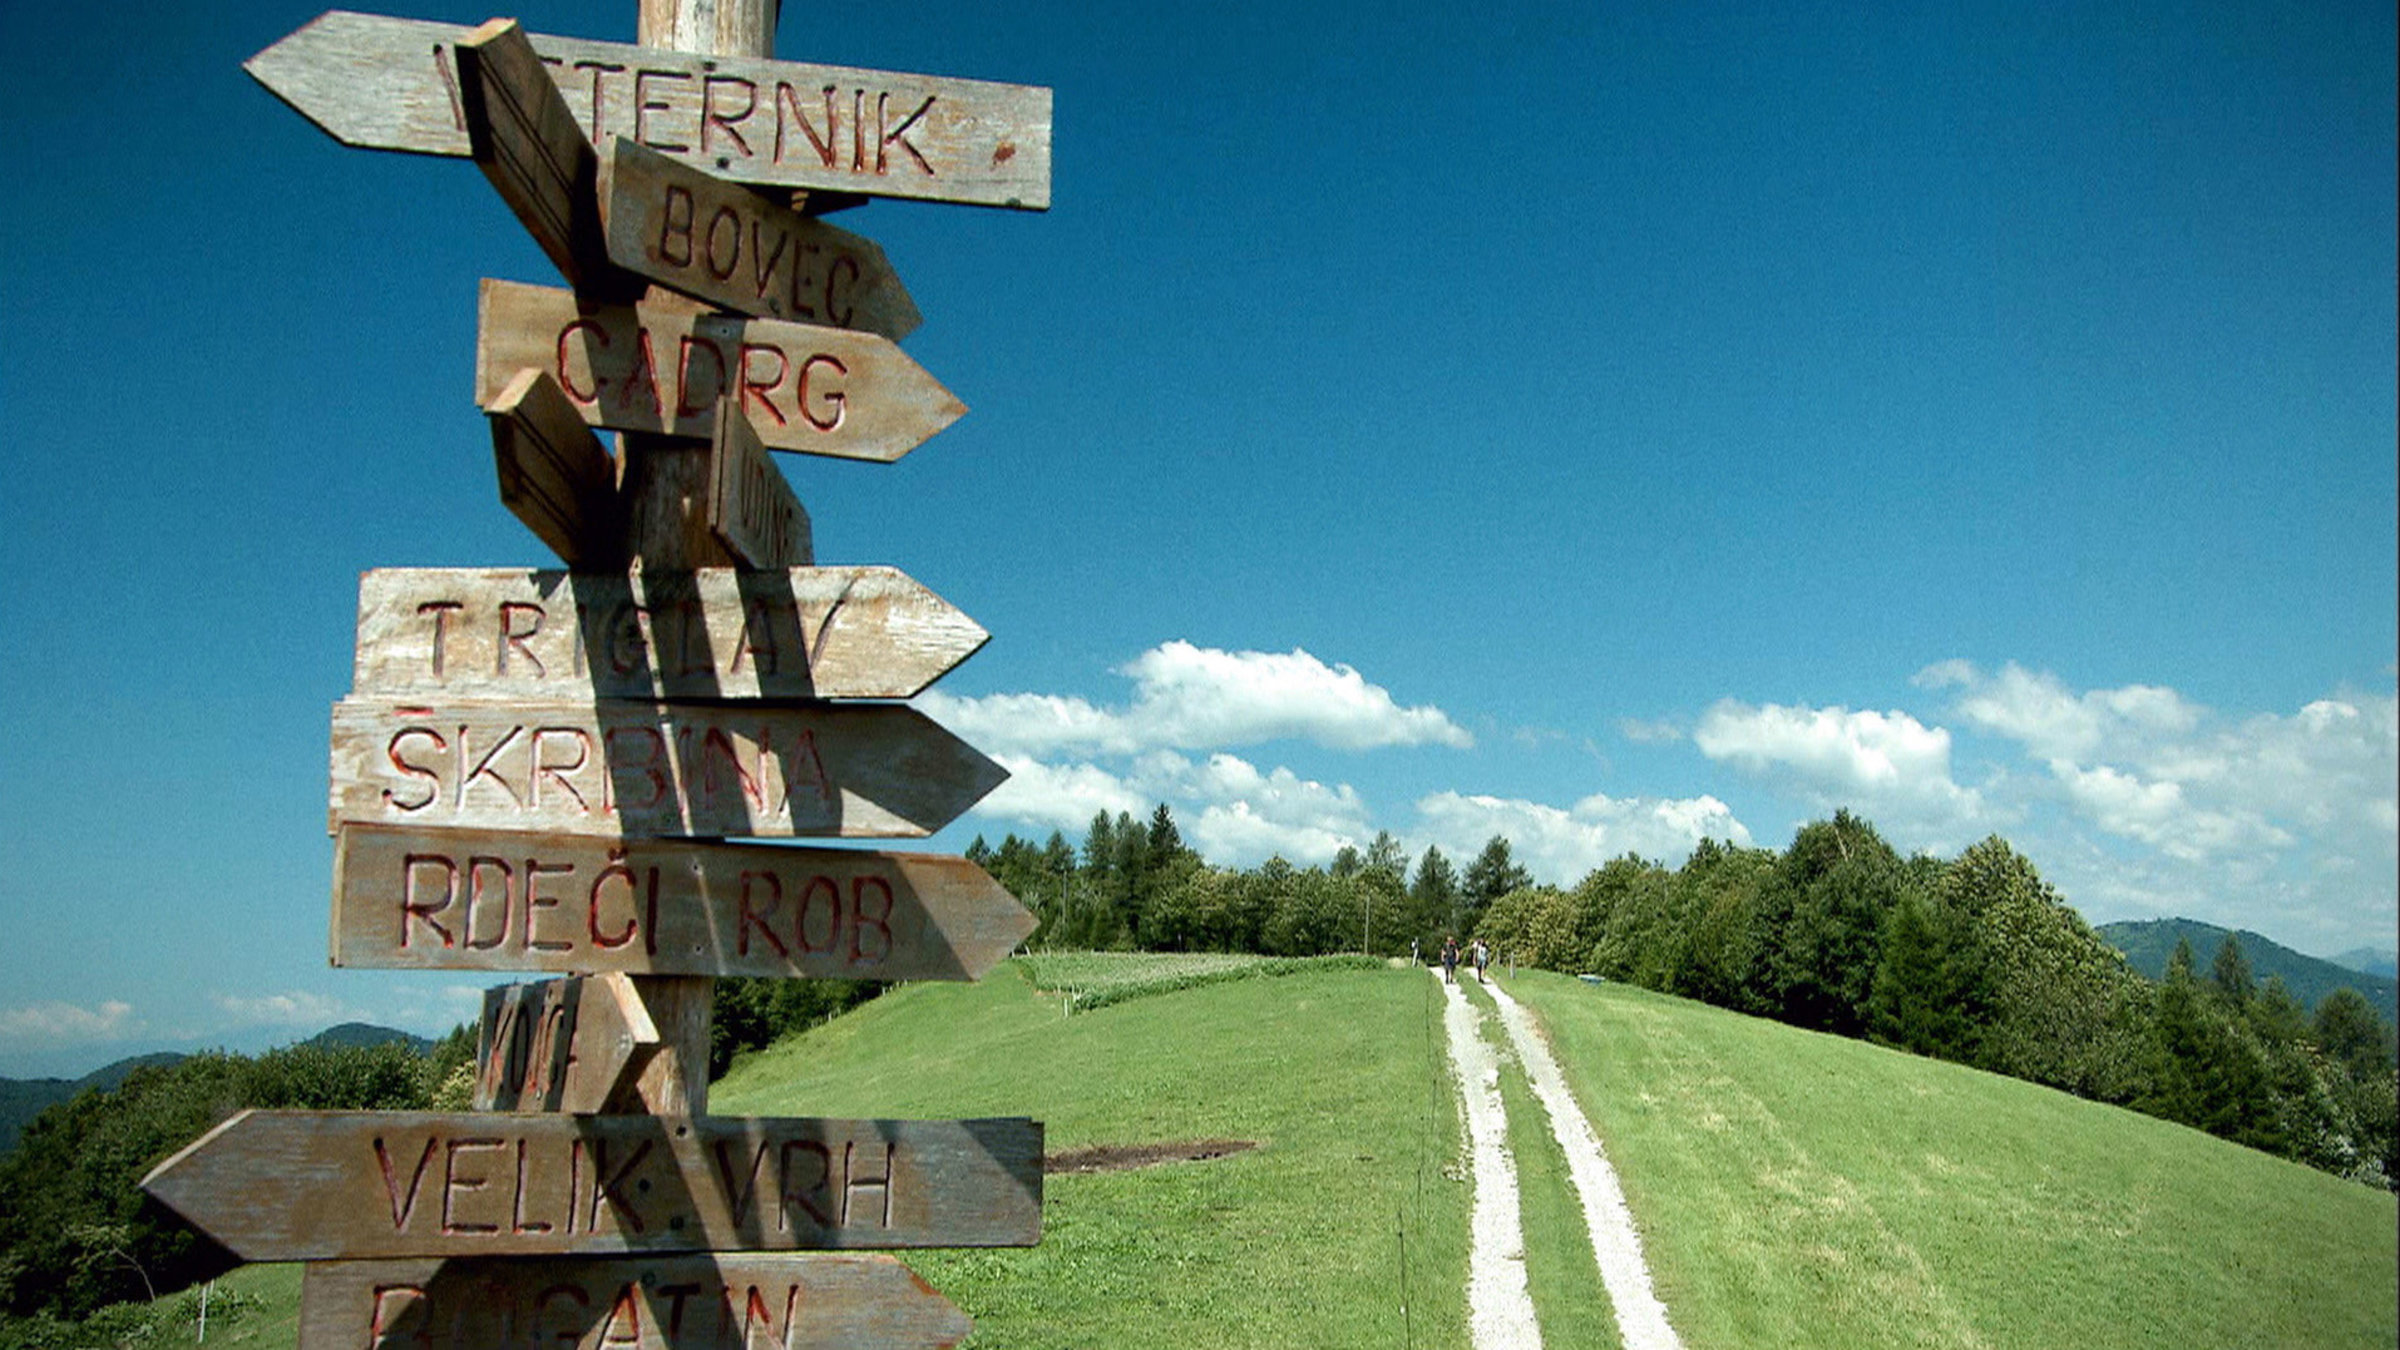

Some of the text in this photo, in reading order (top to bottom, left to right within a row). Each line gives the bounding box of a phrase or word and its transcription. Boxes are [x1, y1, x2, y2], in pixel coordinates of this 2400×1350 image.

[433, 43, 936, 178] TERNIK
[655, 184, 862, 331] BOVEC
[416, 577, 858, 679] TRIGLAV
[380, 704, 832, 817] ŠKRBINA
[399, 848, 897, 965] RDEČI ROB
[371, 1135, 896, 1238] VELIK VRH
